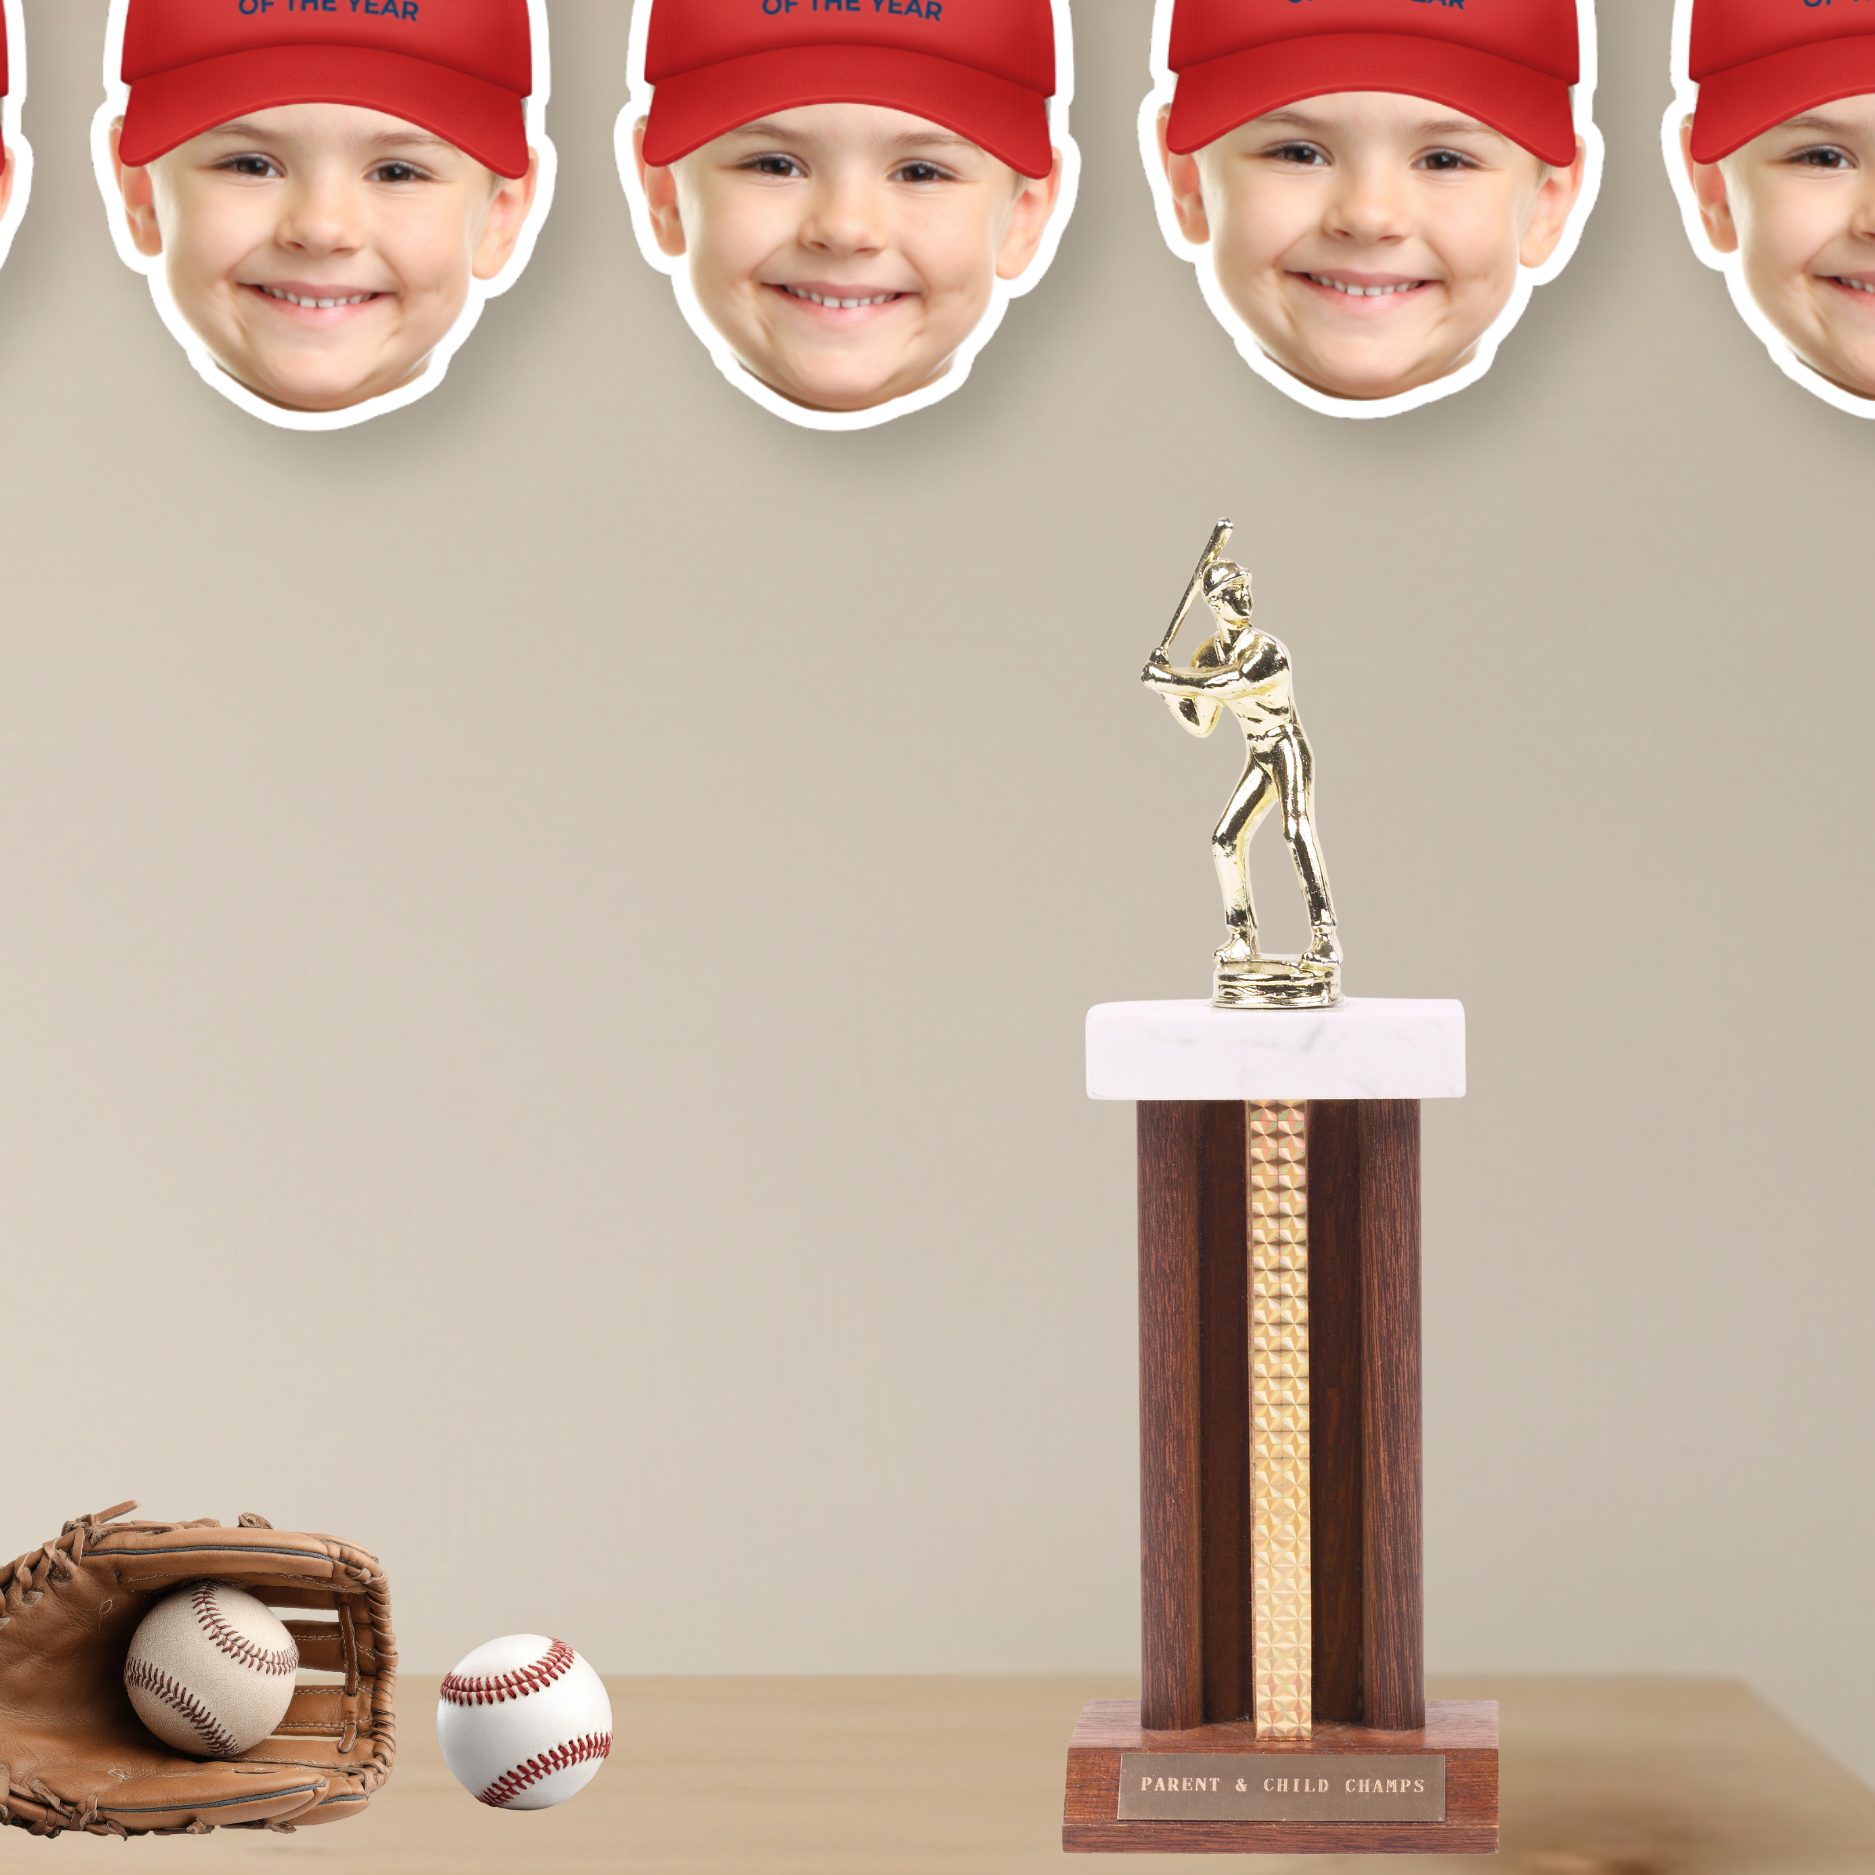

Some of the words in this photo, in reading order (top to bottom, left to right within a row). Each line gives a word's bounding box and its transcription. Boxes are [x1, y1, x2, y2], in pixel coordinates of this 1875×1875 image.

[1140, 1777, 1221, 1793] PARENT
[1234, 1778, 1248, 1793] &
[1263, 1777, 1330, 1794] CHILD
[1345, 1777, 1425, 1794] CHAMPS
